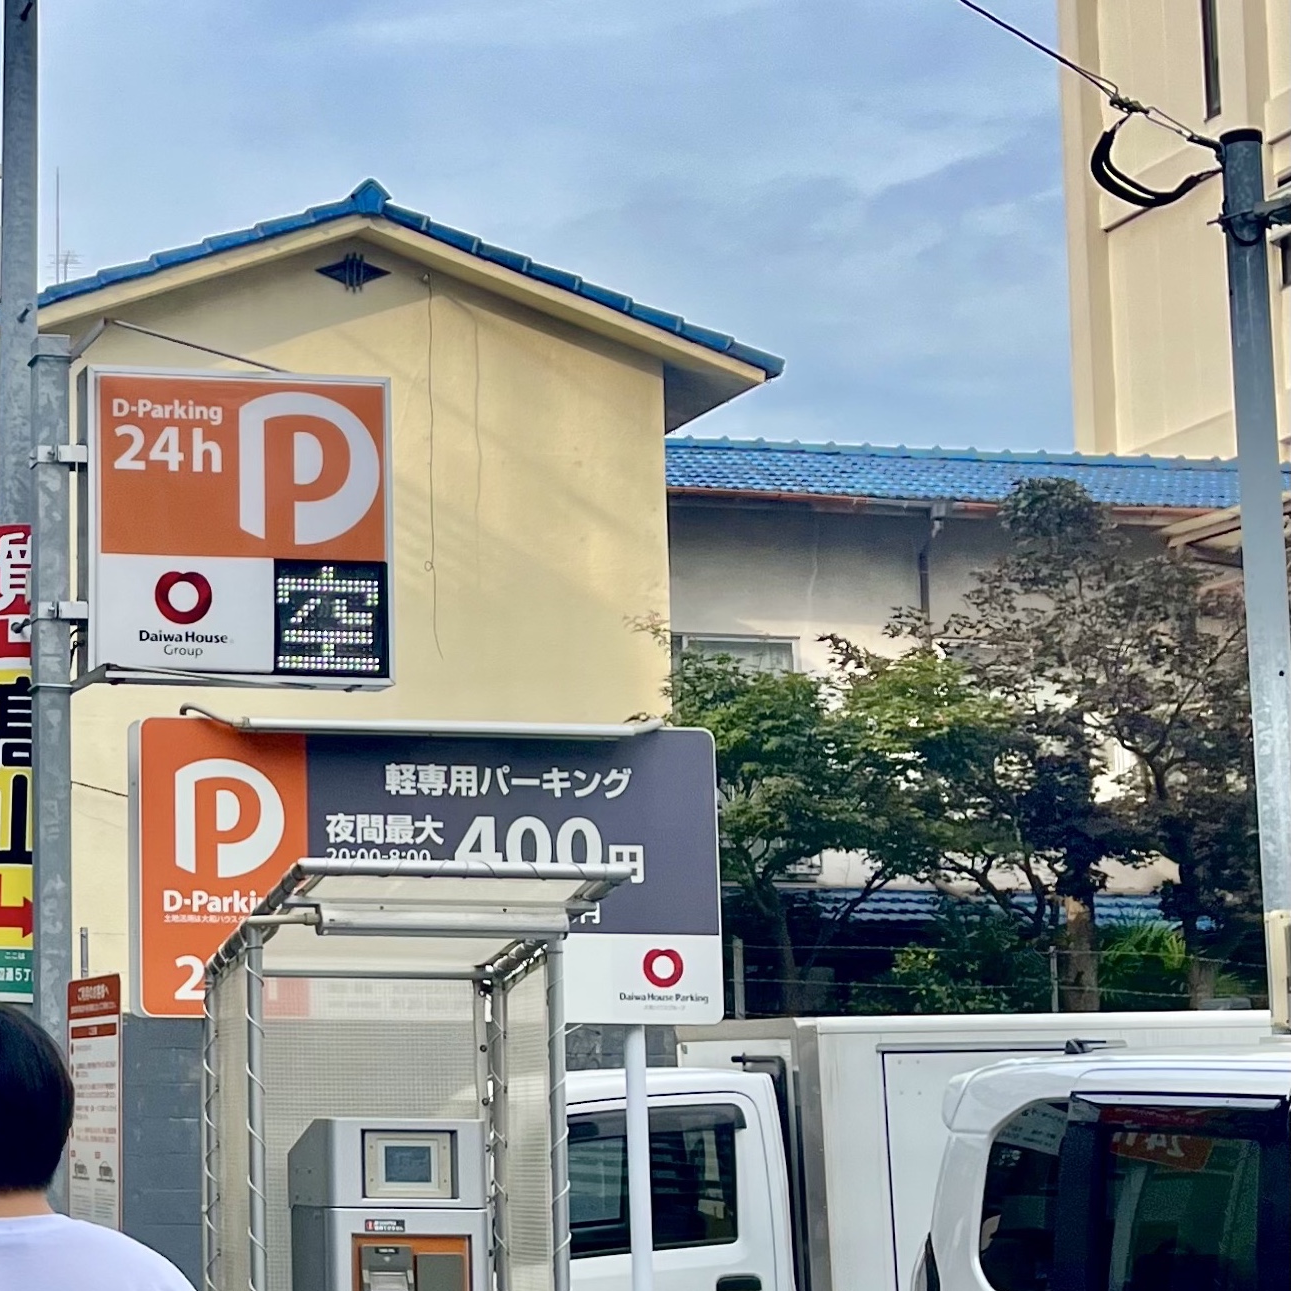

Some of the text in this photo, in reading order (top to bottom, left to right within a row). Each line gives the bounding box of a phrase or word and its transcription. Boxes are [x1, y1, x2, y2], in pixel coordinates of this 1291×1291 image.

[112, 398, 223, 426] D-Parking
[139, 629, 228, 644] Daiwa House
[163, 644, 204, 658] Group
[385, 762, 633, 799] 軽専用パーキング
[325, 812, 445, 845] 夜間最大
[162, 889, 266, 914] D-Parki
[619, 992, 709, 1005] Daiwa House Parking
